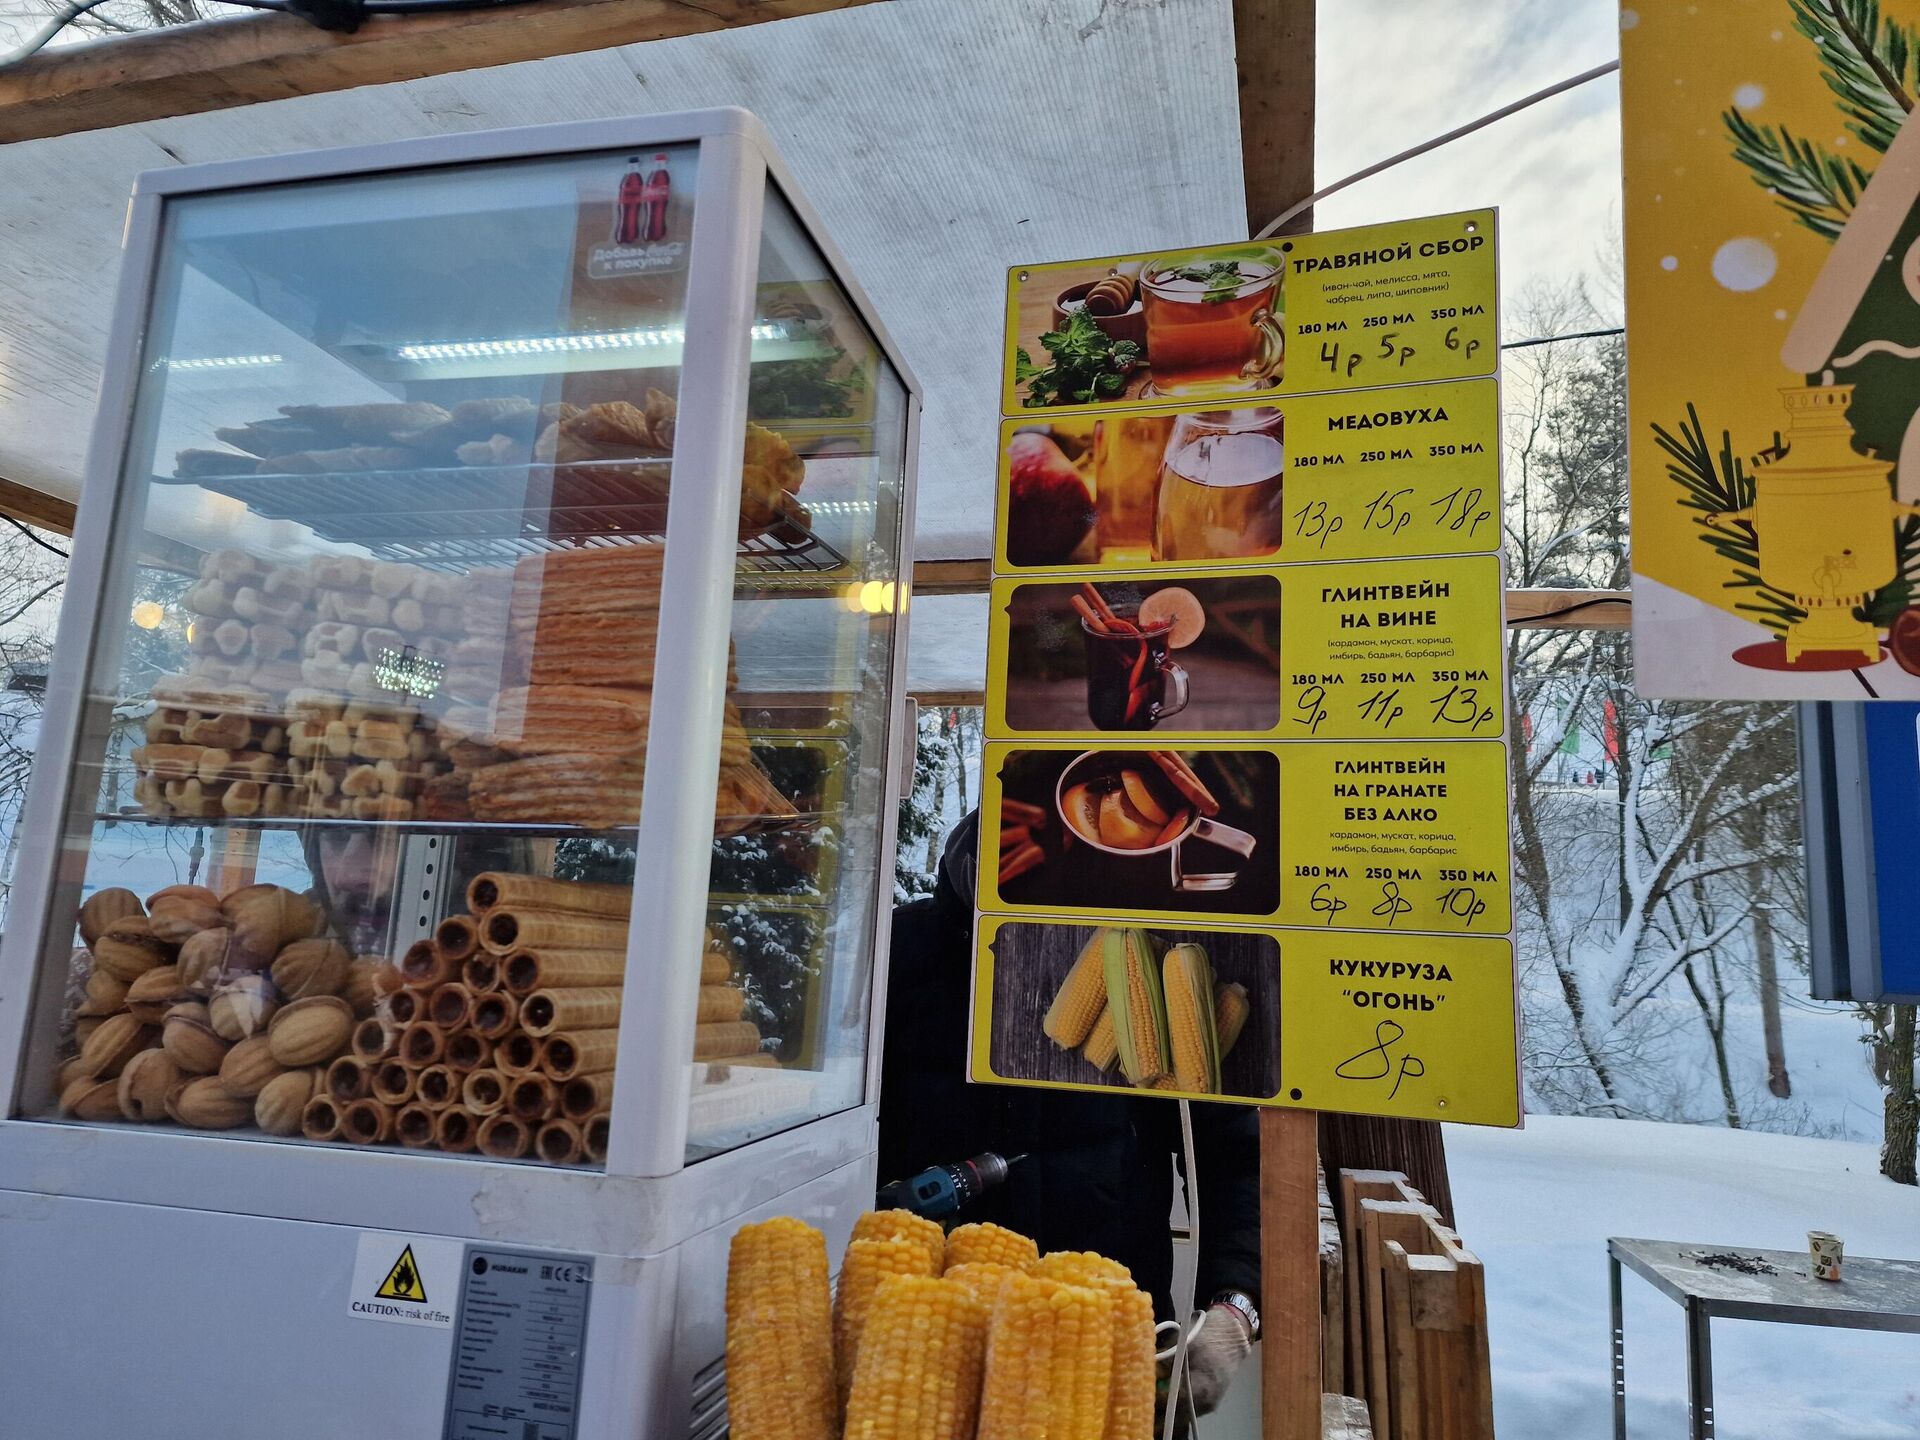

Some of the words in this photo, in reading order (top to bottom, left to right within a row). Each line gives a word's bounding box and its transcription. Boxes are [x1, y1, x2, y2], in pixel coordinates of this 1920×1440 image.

[1293, 242, 1411, 273] ТРАВЯНОЙ
[1419, 236, 1484, 257] СБОР
[1323, 277, 1373, 292] (иван-чай,
[1375, 273, 1420, 286] мелисса,
[1396, 283, 1449, 297] шиповник)
[1299, 323, 1321, 335] 180
[1327, 321, 1347, 331] МЛ
[1363, 316, 1387, 328] 250
[1393, 313, 1415, 324] МЛ
[1431, 308, 1456, 319] 350
[1462, 305, 1484, 316] МЛ
[1329, 407, 1448, 431] МЕДОВУХА
[1294, 456, 1317, 467] 180
[1323, 454, 1344, 465] МЛ
[1360, 451, 1385, 462] 250
[1391, 449, 1413, 460] МЛ
[1430, 445, 1455, 456] 350
[1462, 443, 1484, 454] МЛ
[1322, 580, 1449, 602] ГЛИНТВЕЙН
[1341, 613, 1370, 628] НА
[1378, 611, 1436, 627] ВИНЕ
[1405, 650, 1454, 658] барбарис)
[1292, 675, 1316, 684] 180
[1322, 674, 1344, 684] МЛ
[1360, 673, 1386, 683] 250
[1392, 672, 1415, 682] МЛ
[1432, 671, 1459, 682] 350
[1466, 670, 1489, 681] МЛ
[1335, 757, 1445, 773] ГЛИНТВЕЙН
[1334, 784, 1359, 796] НА
[1366, 785, 1447, 797] ГРАНАТЕ
[1345, 808, 1377, 820] БЕЗ
[1383, 808, 1437, 821] АЛКО
[1330, 832, 1379, 840] кардамон,
[1409, 846, 1457, 855] барбарис
[1295, 866, 1320, 877] 180
[1326, 867, 1348, 877] МЛ
[1366, 868, 1392, 879] 250
[1398, 869, 1421, 880] МЛ
[1440, 870, 1466, 881] 350
[1473, 871, 1497, 882] МЛ
[1330, 959, 1453, 981] КУКУРУЗА
[352, 1301, 404, 1317] CAUTION:
[405, 1307, 422, 1320] risk
[424, 1309, 434, 1321] of
[434, 1311, 450, 1323] fire
